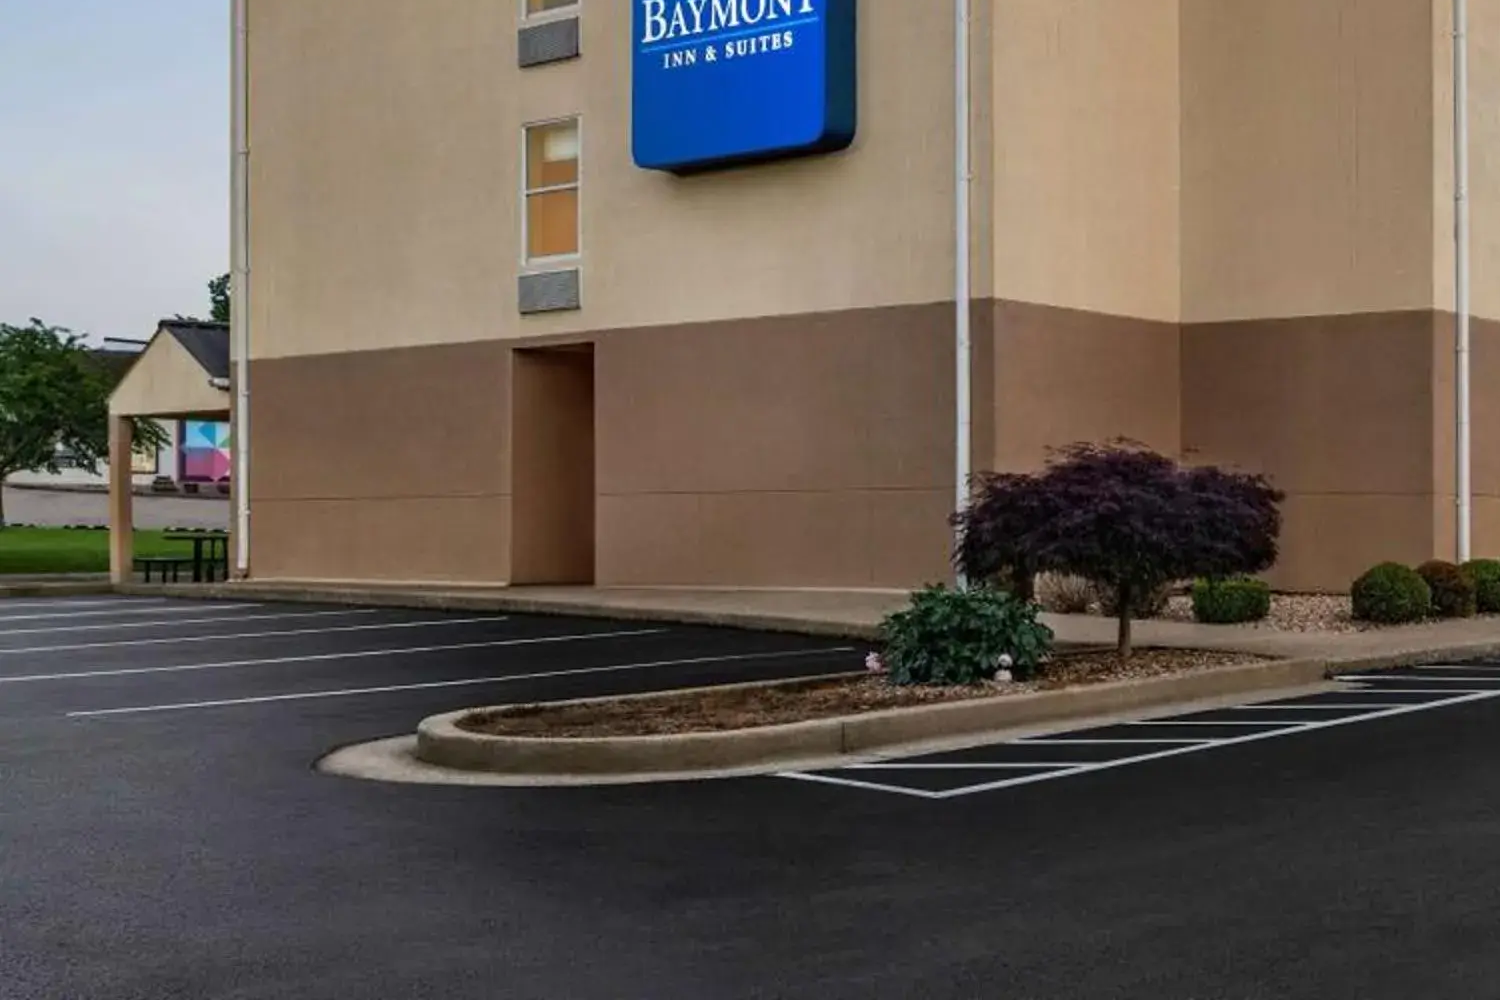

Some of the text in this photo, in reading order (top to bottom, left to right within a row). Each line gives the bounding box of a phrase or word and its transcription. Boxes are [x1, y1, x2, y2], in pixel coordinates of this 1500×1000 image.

[663, 31, 794, 69] INN & SUITES
